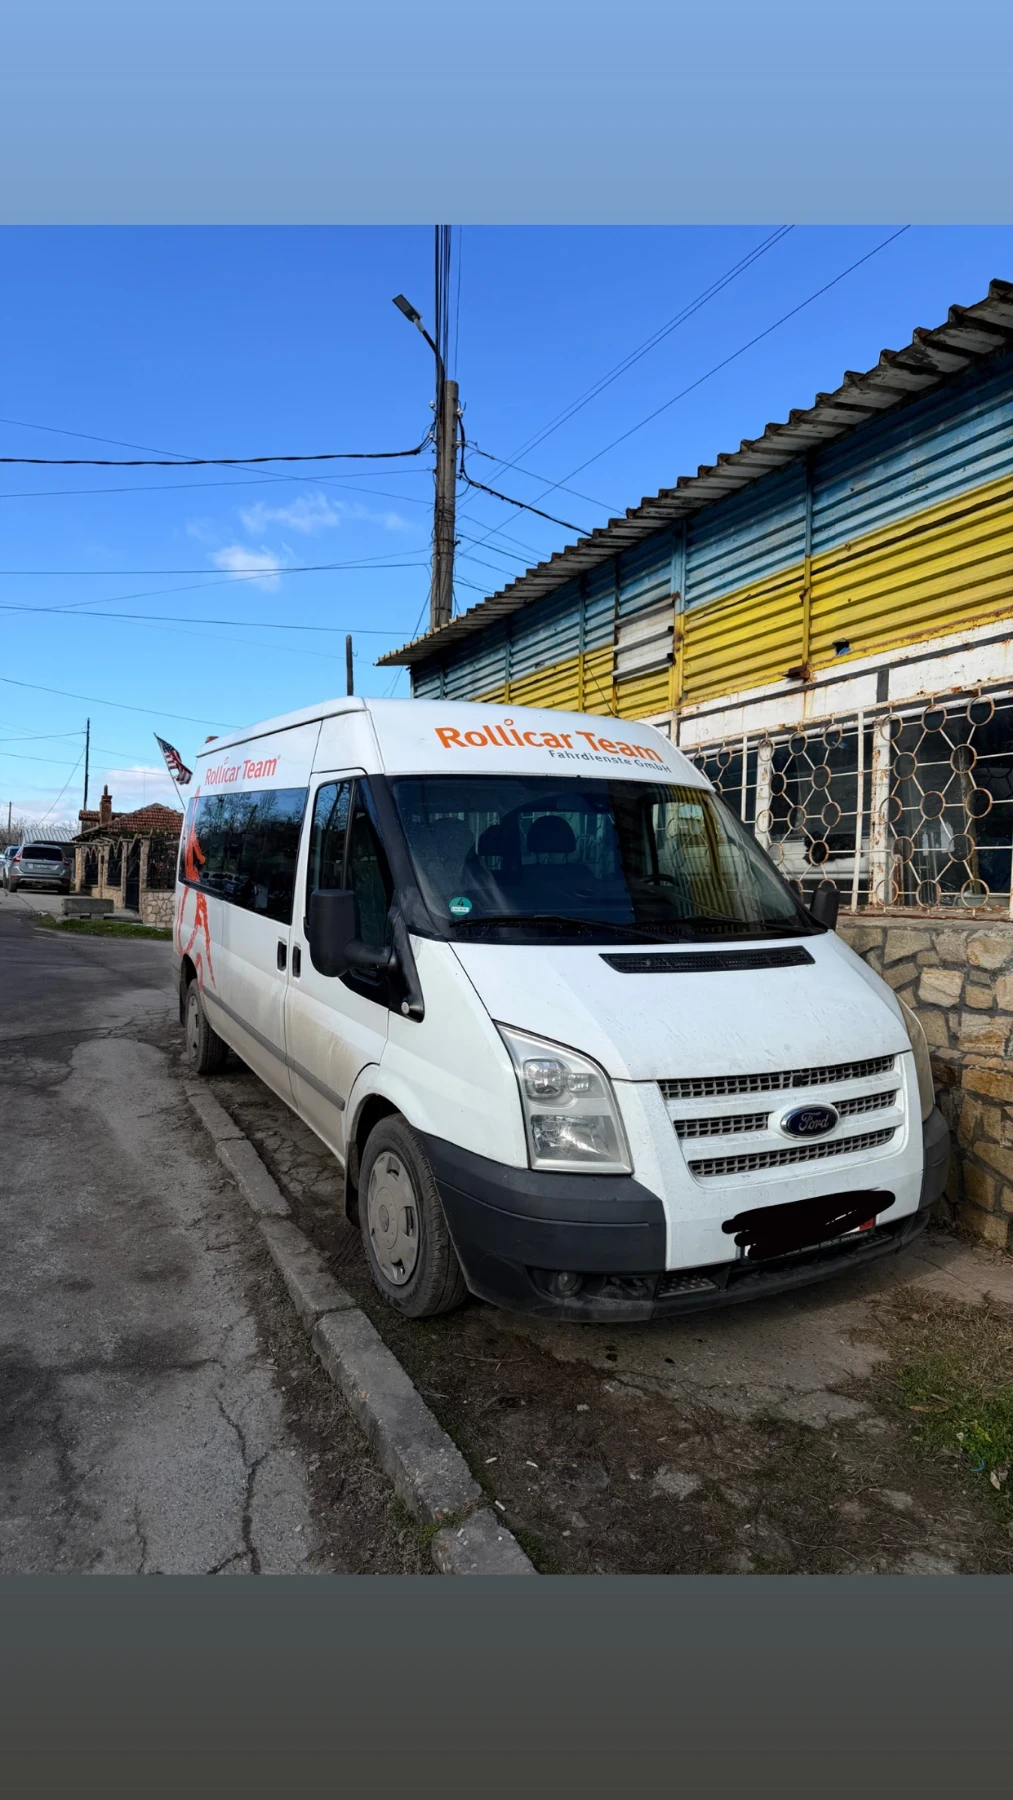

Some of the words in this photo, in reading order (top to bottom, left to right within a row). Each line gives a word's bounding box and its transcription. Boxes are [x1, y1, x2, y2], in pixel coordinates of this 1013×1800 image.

[434, 718, 573, 749] Rollicar
[575, 730, 664, 763] Team
[205, 757, 241, 785] Rollicar
[548, 750, 632, 765] Fahrdienste
[635, 758, 673, 773] GmbH
[457, 898, 464, 906] 4
[798, 1112, 830, 1131] Ford
